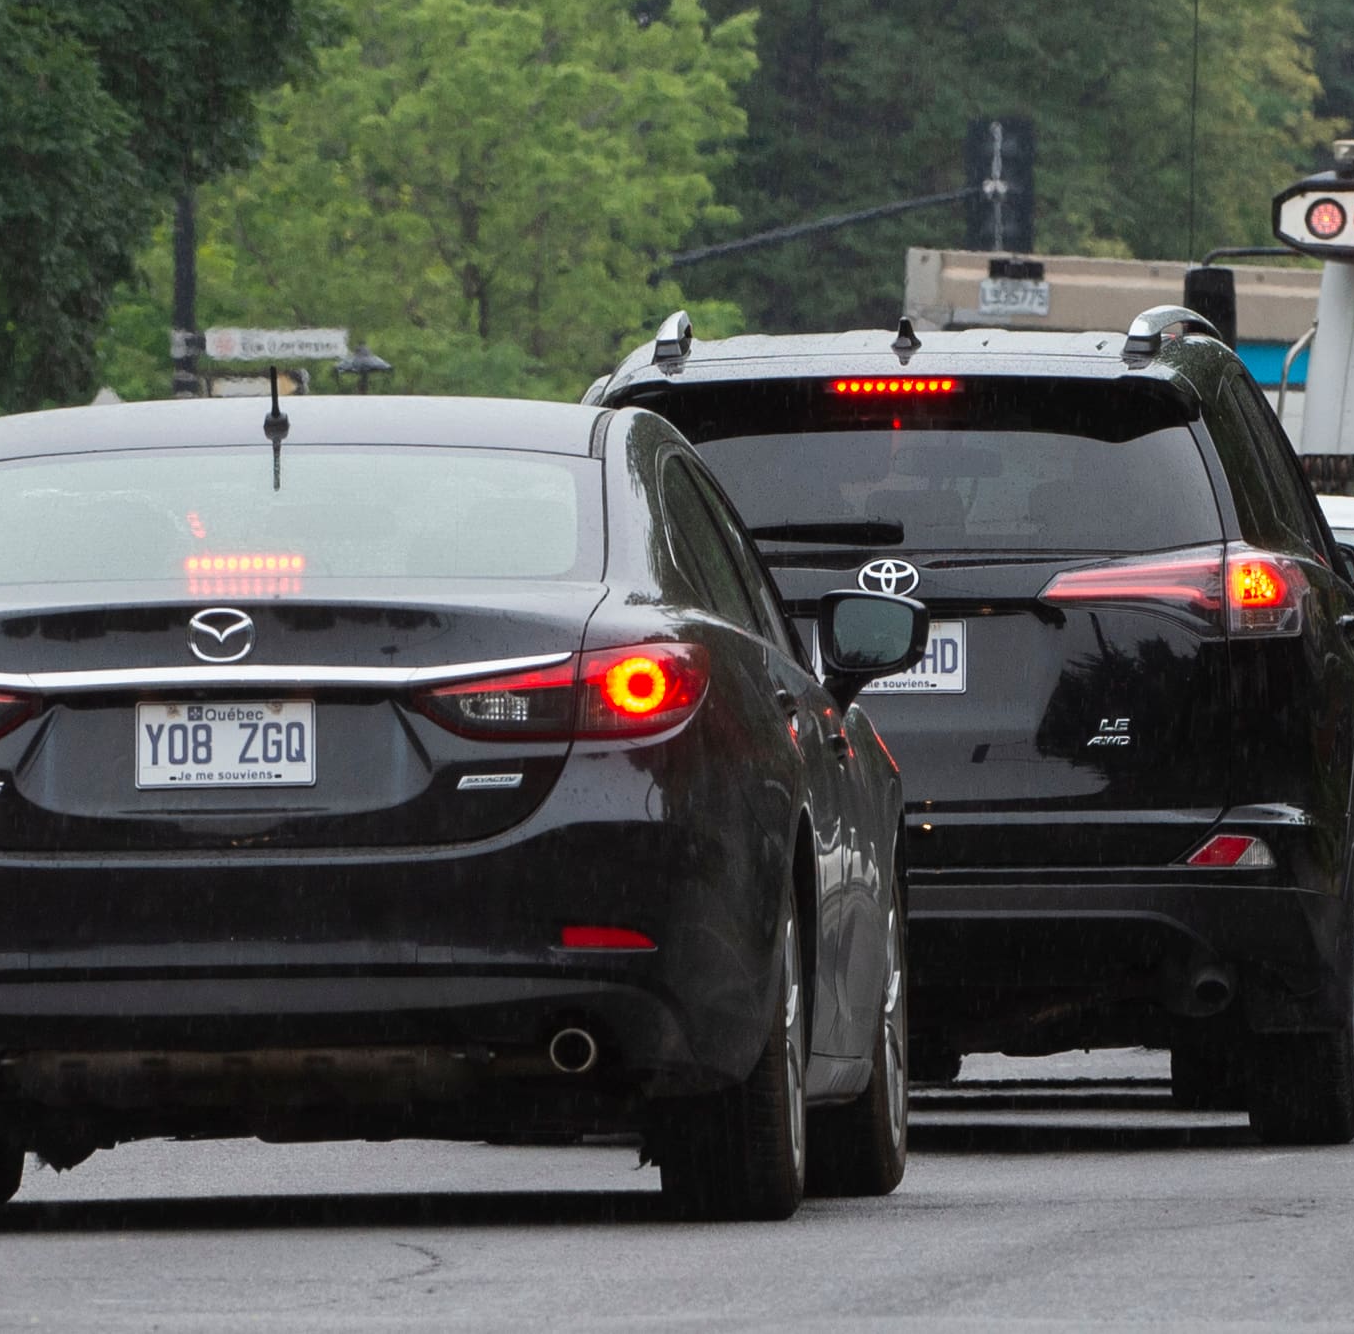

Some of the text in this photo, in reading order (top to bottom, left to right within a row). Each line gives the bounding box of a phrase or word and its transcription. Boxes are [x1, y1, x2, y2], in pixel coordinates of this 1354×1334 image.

[903, 638, 958, 675] HD
[883, 678, 930, 689] souviens
[204, 708, 264, 721] Québec
[1099, 718, 1131, 731] LE
[145, 722, 306, 766] Y08 ZGQ
[1087, 735, 1131, 747] AWD
[178, 769, 274, 781] Je me souviens
